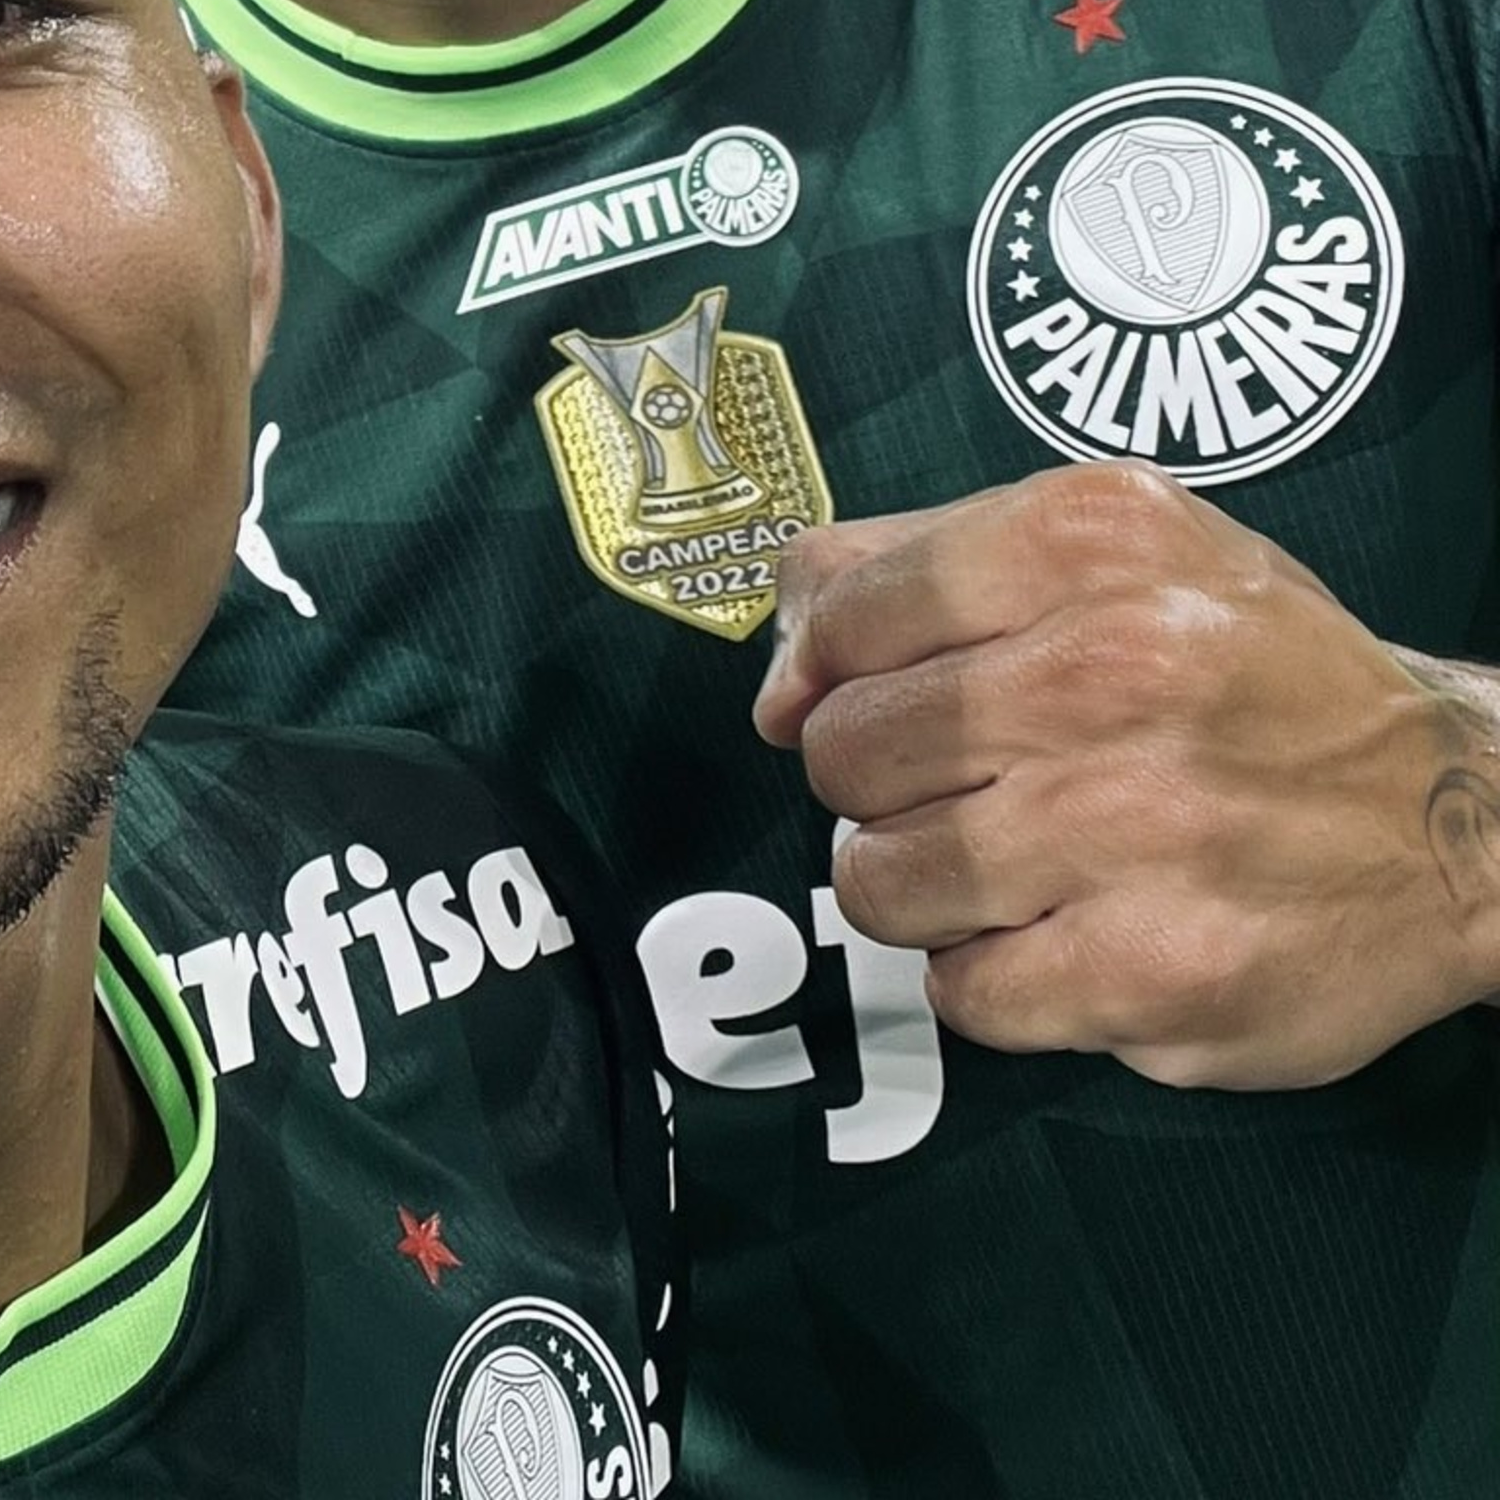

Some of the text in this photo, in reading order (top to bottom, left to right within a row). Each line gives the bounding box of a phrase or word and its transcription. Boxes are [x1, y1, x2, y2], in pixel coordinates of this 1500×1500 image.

[482, 176, 686, 291] AVANTI
[690, 166, 788, 236] PALMEIRAS
[1002, 214, 1372, 458] PALMEIRAS
[620, 517, 807, 575] CAMPEÃO
[671, 561, 776, 601] 2022
[157, 842, 576, 1100] refisa
